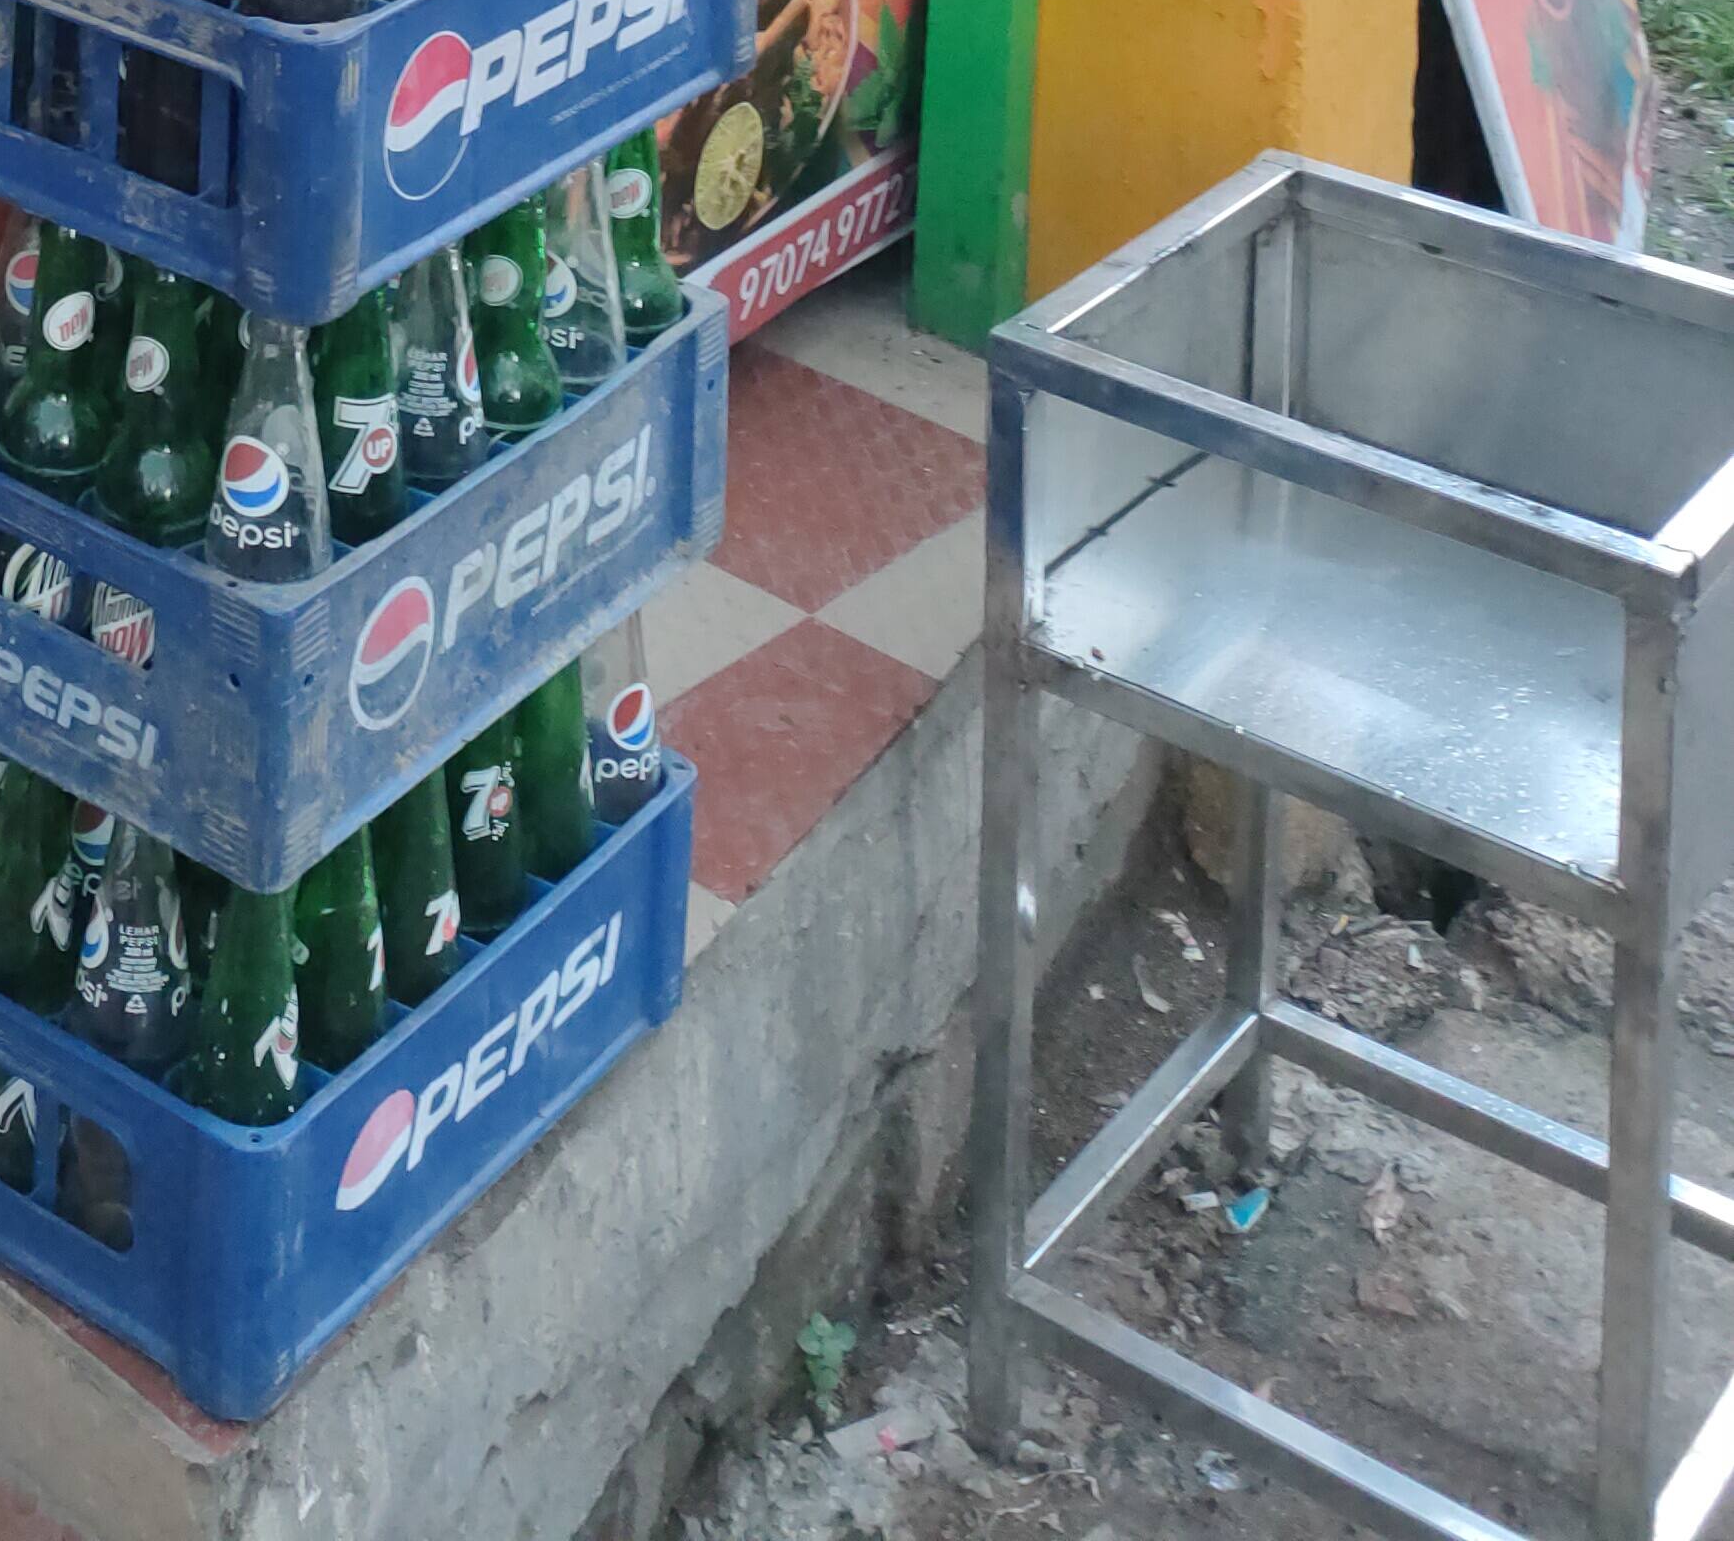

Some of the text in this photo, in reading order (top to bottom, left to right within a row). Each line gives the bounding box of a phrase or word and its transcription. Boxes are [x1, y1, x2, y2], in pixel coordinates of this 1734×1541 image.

[739, 173, 911, 322] 97074 9772
[442, 423, 652, 651] PEPSI
[407, 910, 623, 1172] PEPSI
